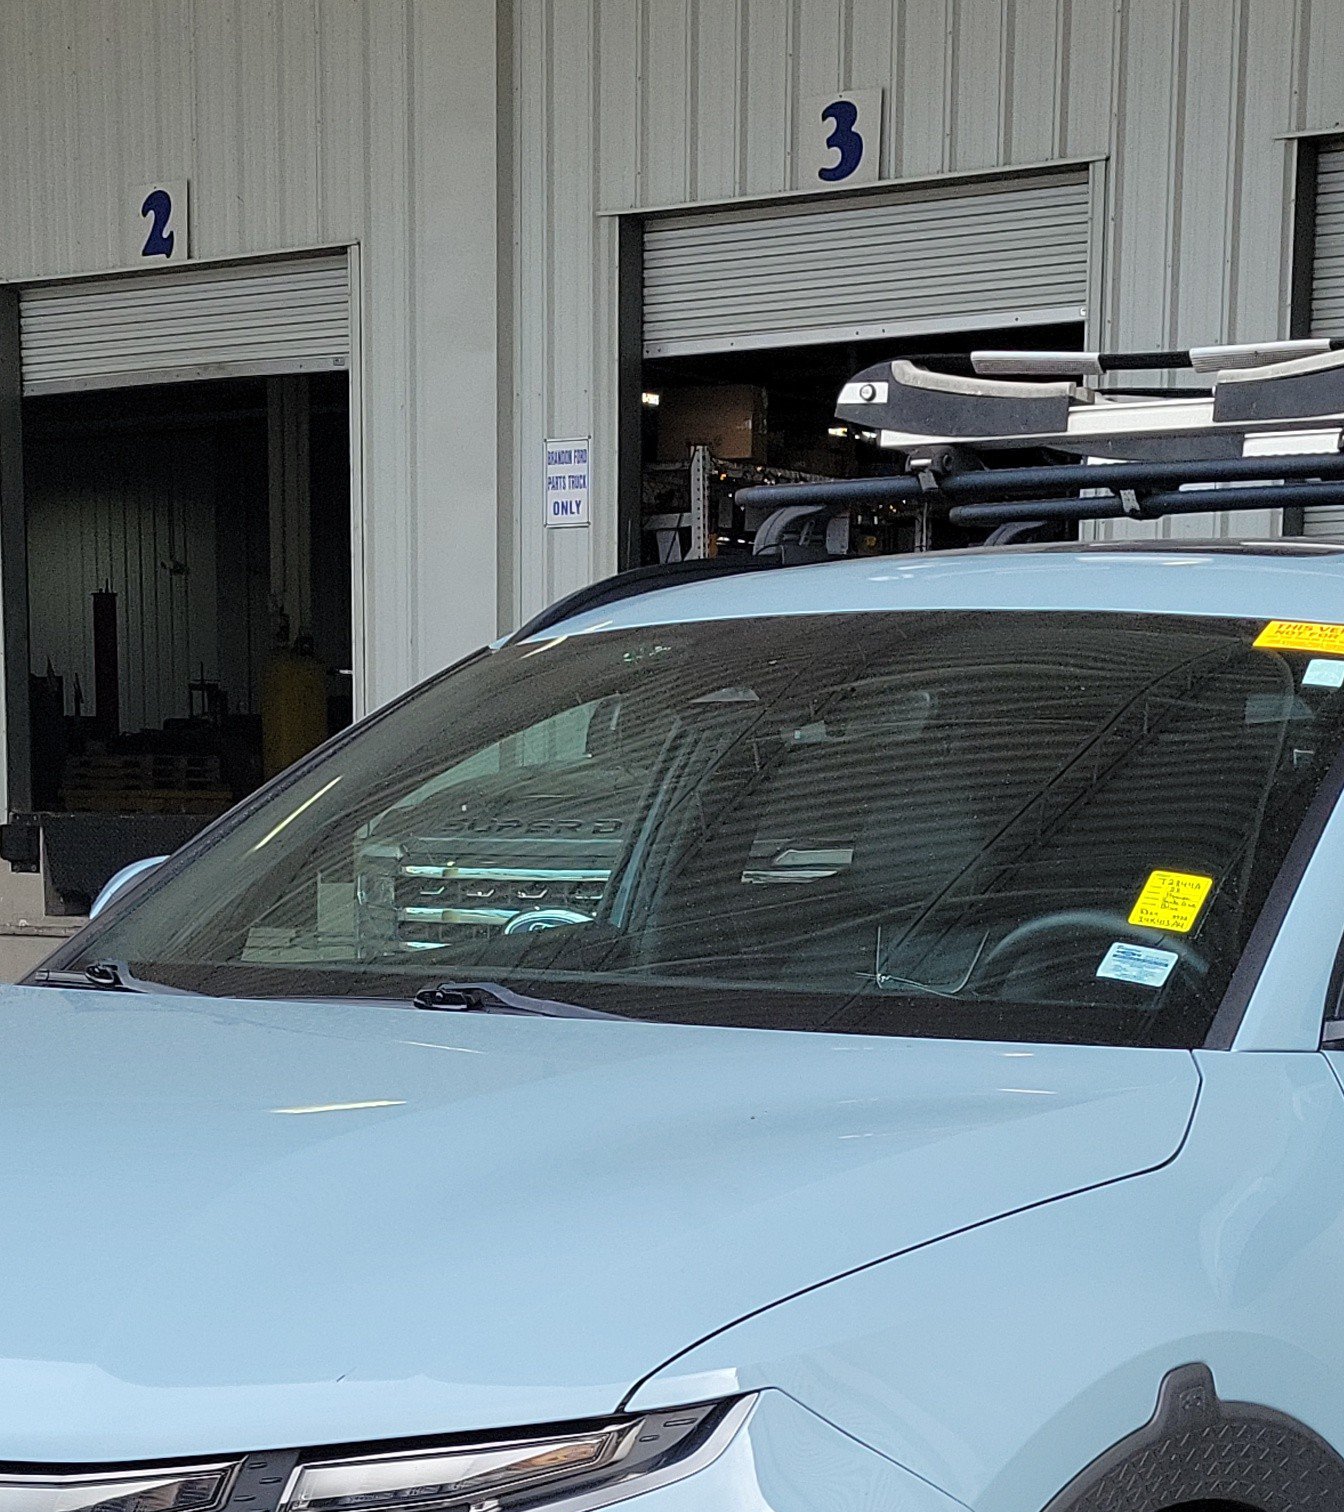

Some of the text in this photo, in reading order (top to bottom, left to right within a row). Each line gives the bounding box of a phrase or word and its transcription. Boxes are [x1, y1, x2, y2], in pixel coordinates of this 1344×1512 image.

[818, 101, 863, 181] 3
[141, 190, 174, 258] 2
[553, 500, 581, 515] ONLY
[1275, 630, 1304, 638] NOT
[1309, 632, 1338, 640] FOR
[1277, 623, 1313, 632] THIS
